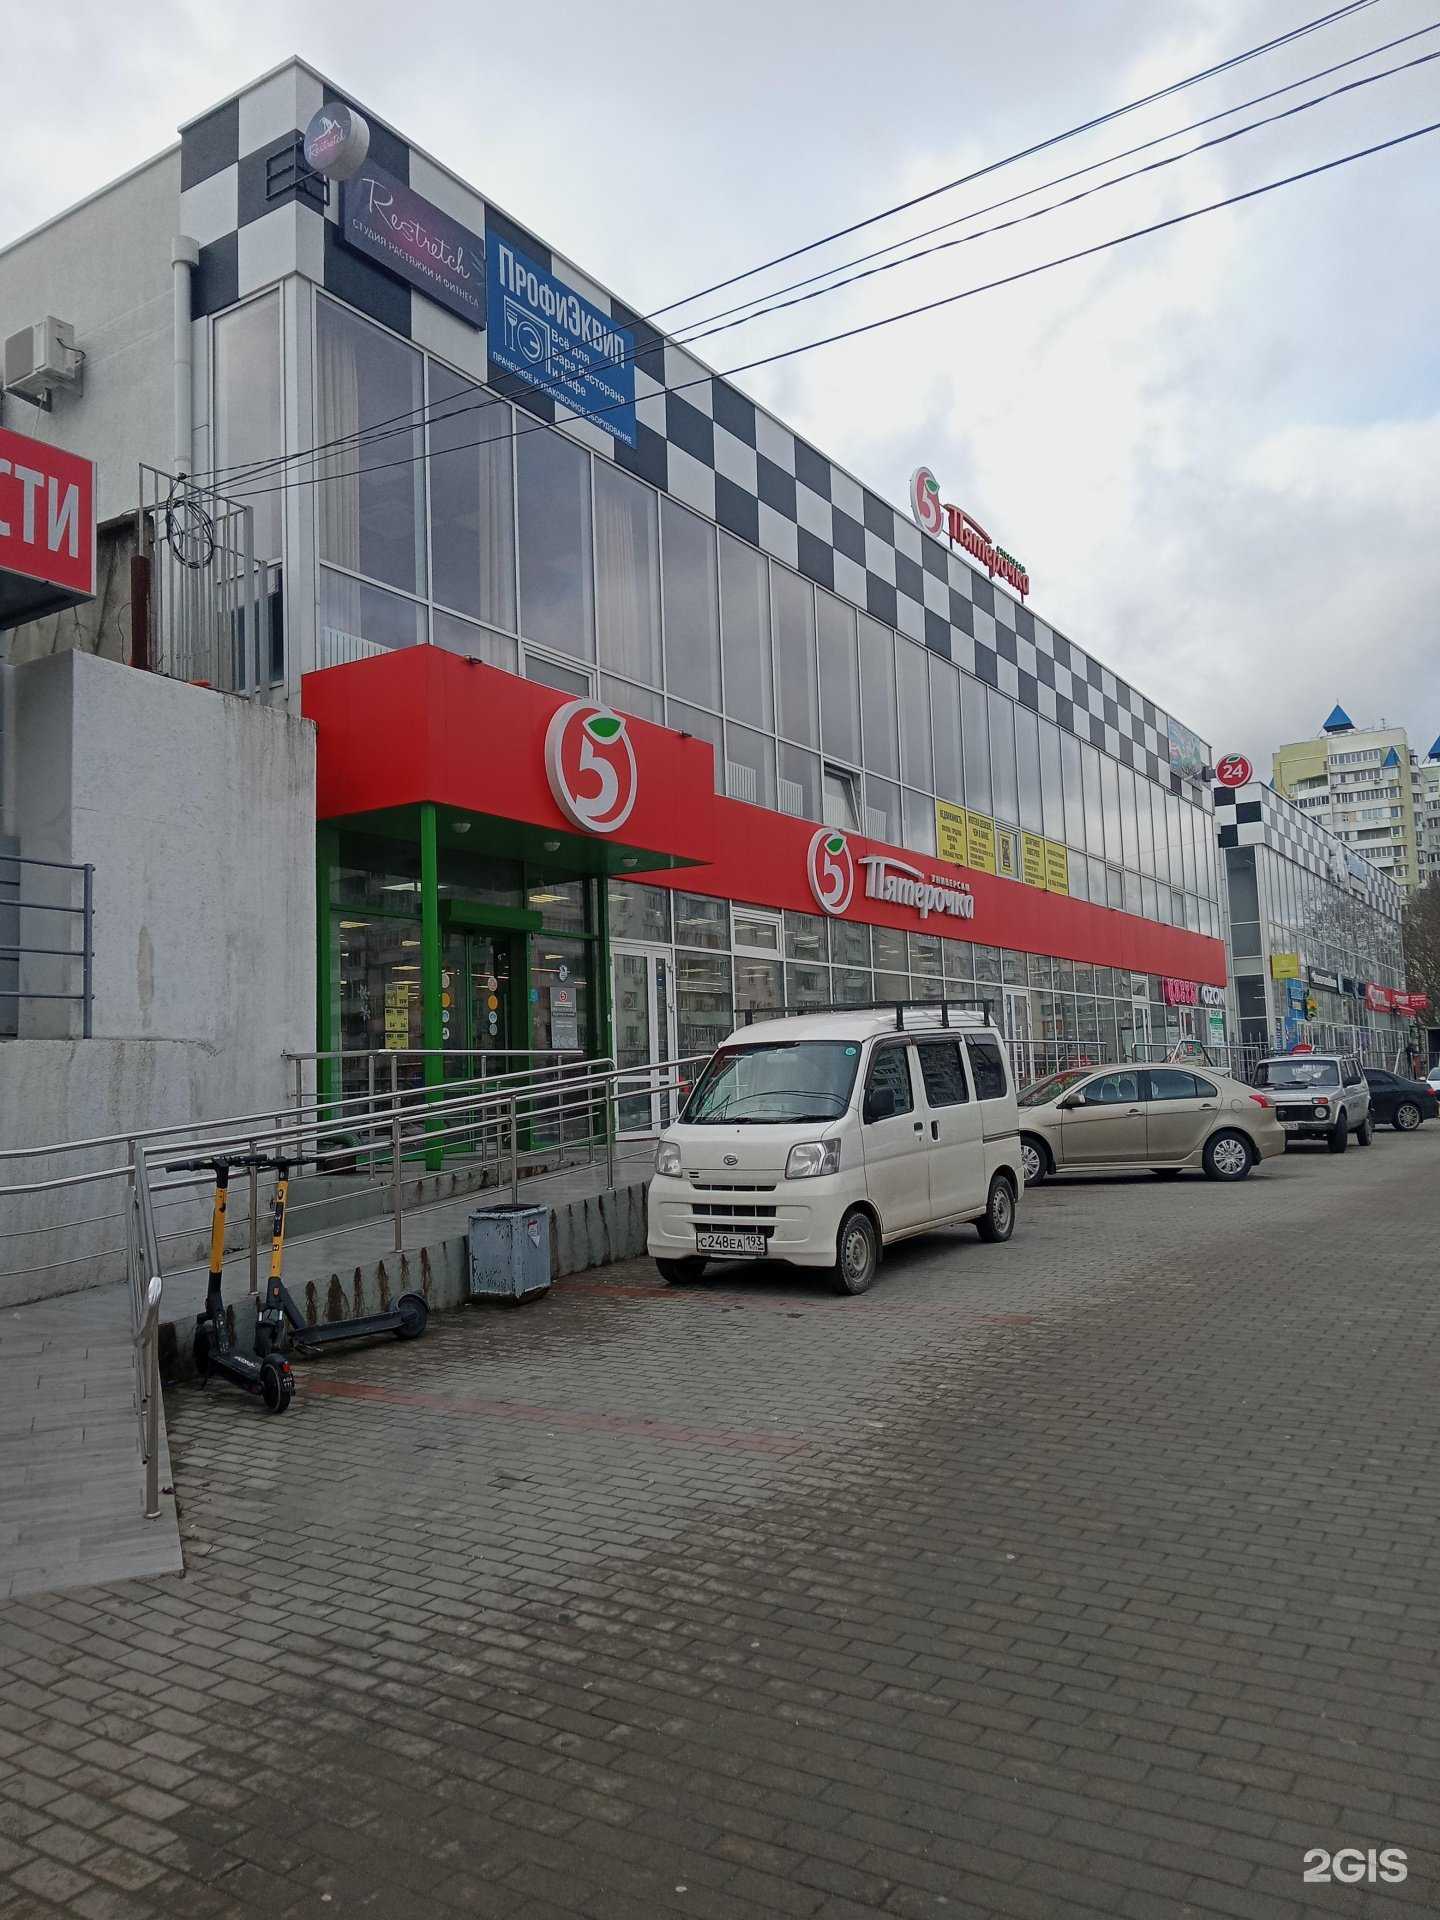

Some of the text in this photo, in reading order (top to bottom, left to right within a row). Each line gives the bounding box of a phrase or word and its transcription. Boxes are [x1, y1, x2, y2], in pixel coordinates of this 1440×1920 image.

[360, 178, 470, 279] Restretch
[352, 218, 387, 247] СТУДИЯ
[443, 278, 479, 309] ФИТНЕСА
[551, 328, 590, 365] Всё для
[551, 346, 576, 372] Бара
[1222, 764, 1244, 779] 24
[857, 855, 974, 919] Пятерочка
[1202, 986, 1225, 1004] OZON
